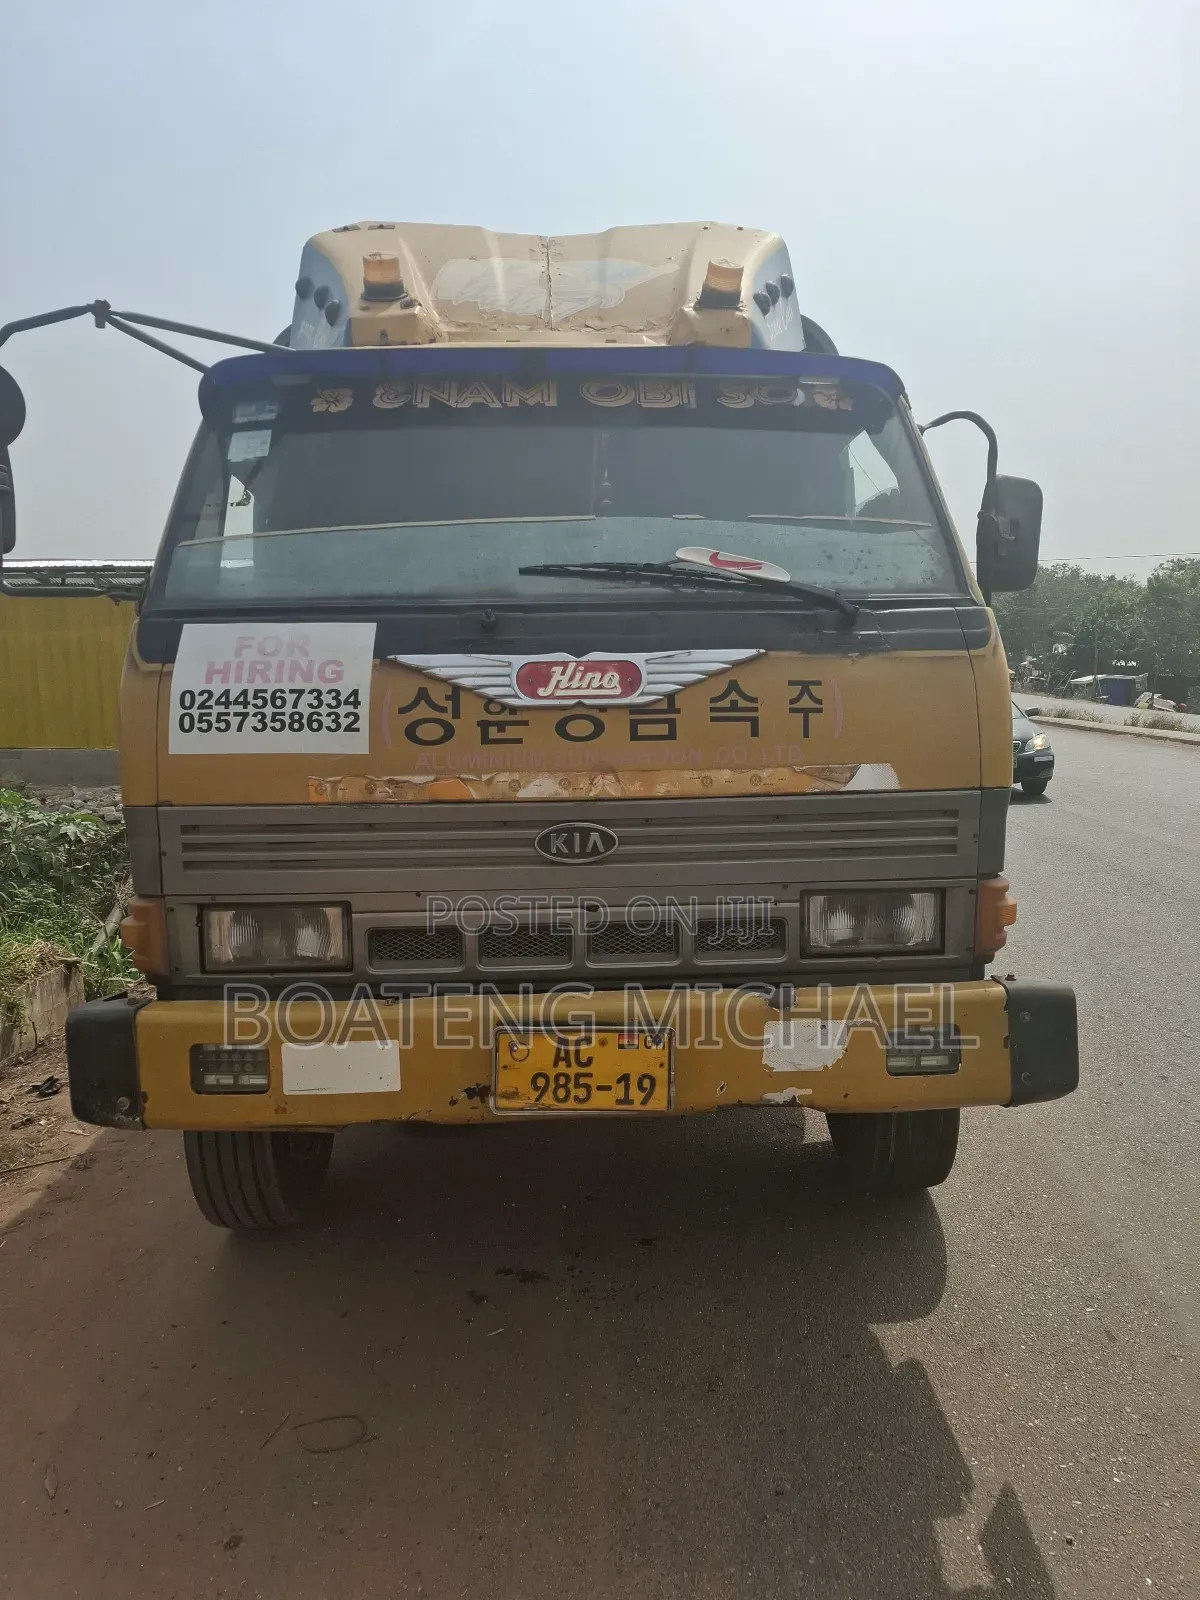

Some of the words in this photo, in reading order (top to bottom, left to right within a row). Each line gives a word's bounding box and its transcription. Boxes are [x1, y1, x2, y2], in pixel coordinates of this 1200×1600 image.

[579, 379, 697, 408] OBI
[717, 380, 806, 409] SO
[234, 635, 312, 658] FOR
[205, 659, 345, 685] HIRING
[537, 662, 622, 697] Hino
[179, 688, 361, 711] 0244567334
[178, 711, 361, 733] 0557358632
[549, 832, 605, 854] KIA
[552, 1036, 594, 1069] AC
[530, 1071, 657, 1106] 985-19
